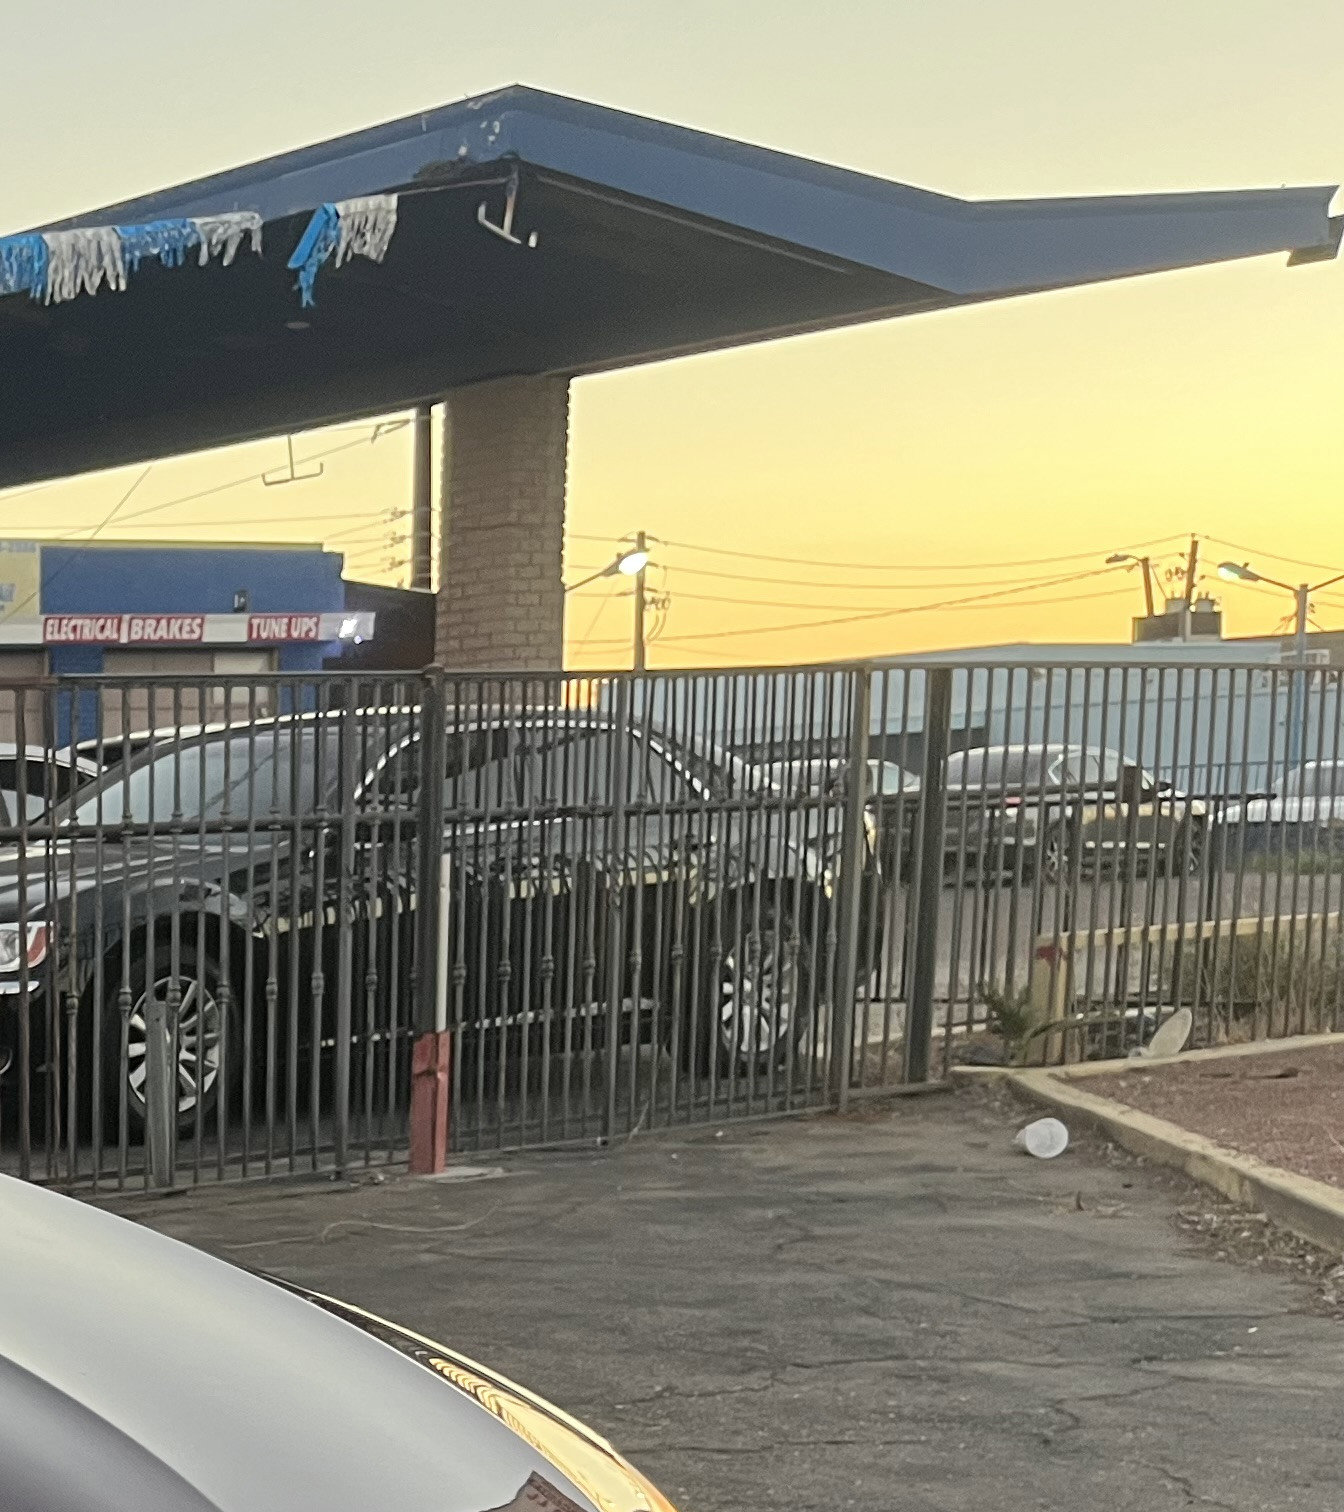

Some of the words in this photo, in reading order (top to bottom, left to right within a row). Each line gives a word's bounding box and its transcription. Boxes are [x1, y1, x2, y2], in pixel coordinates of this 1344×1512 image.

[45, 617, 120, 641] ELECTRICAL
[128, 617, 203, 641] BRAKES
[250, 617, 289, 640] TUNE
[290, 616, 317, 640] UPS
